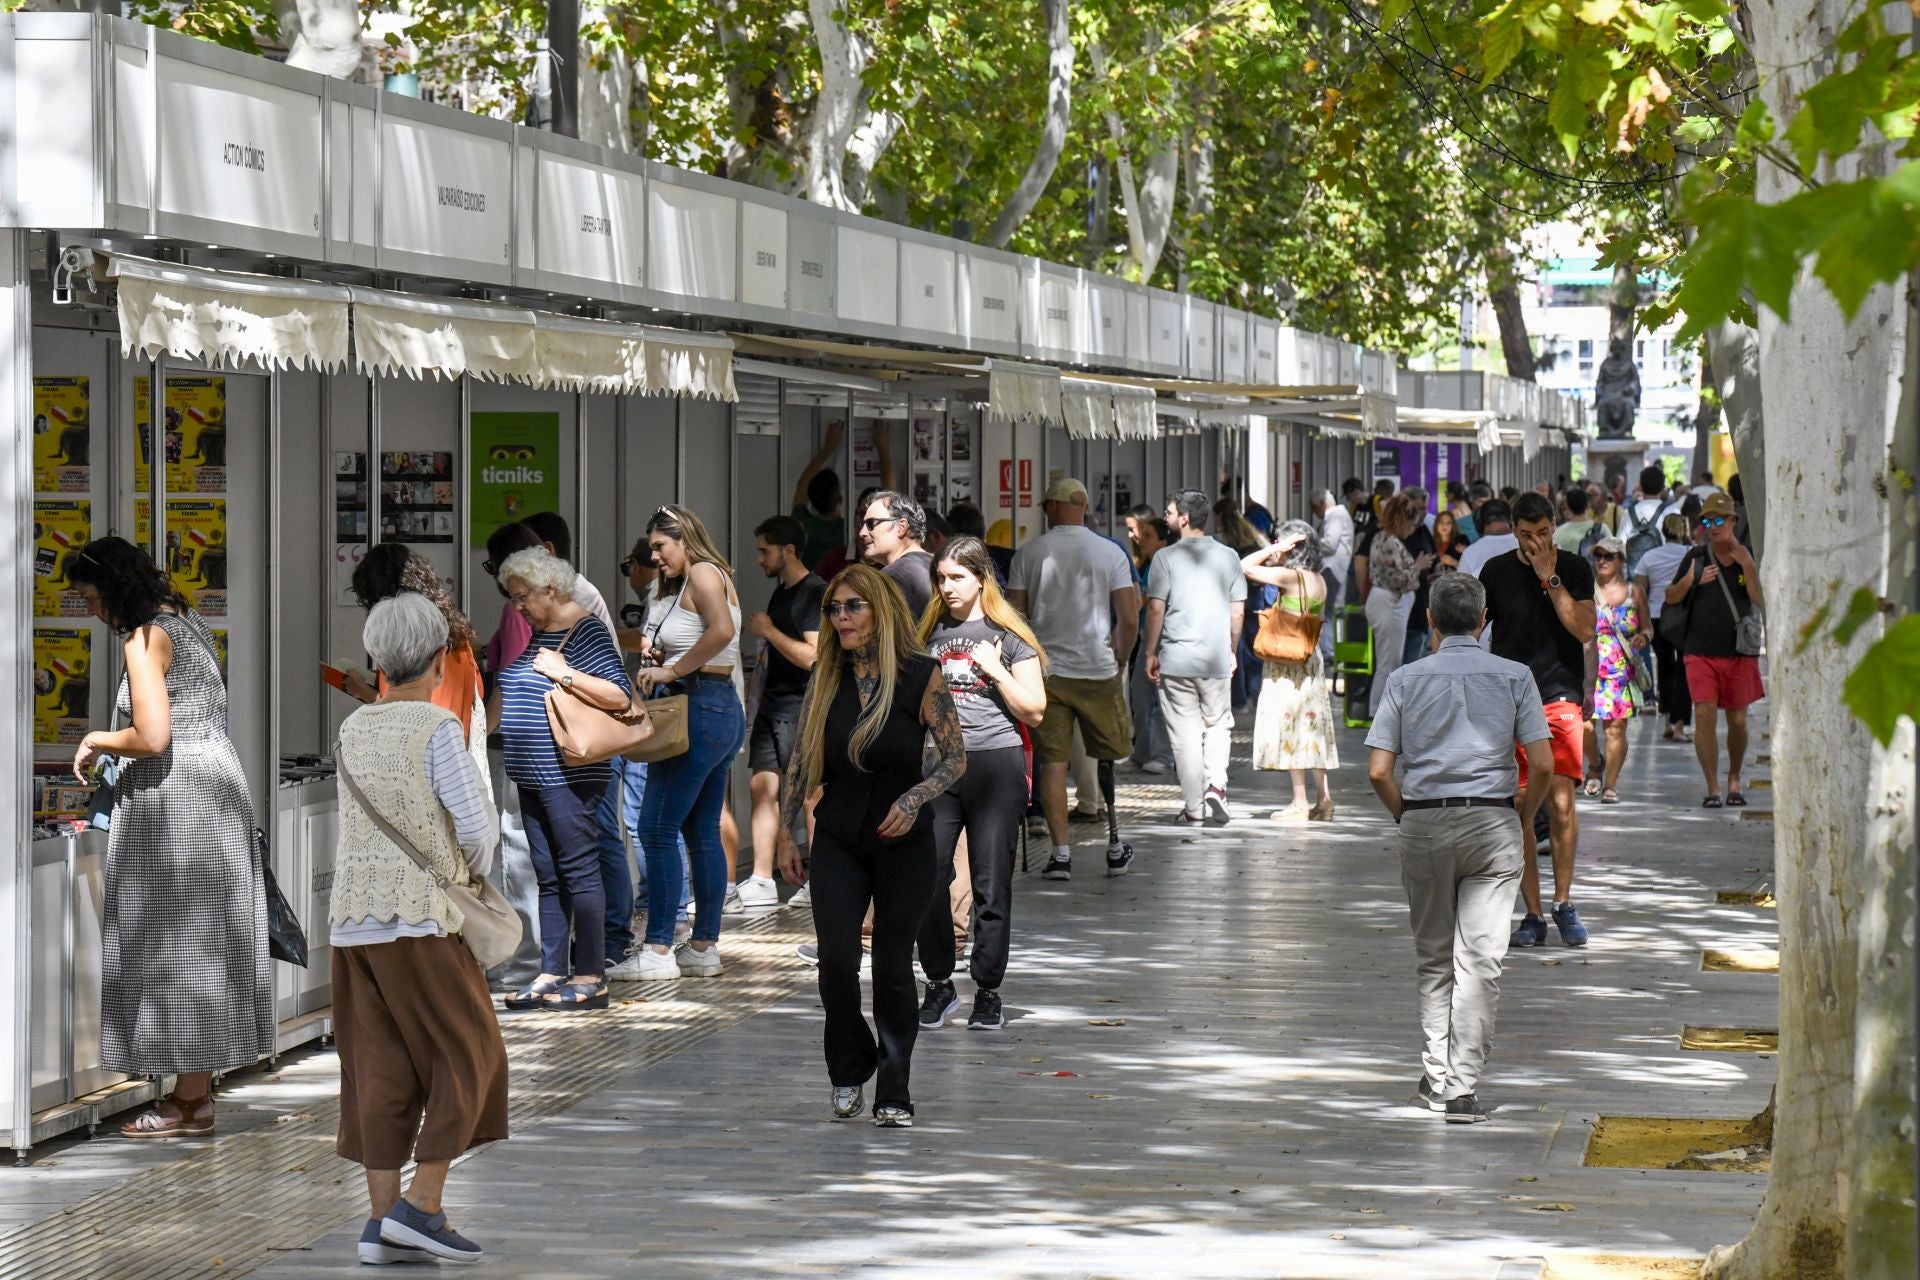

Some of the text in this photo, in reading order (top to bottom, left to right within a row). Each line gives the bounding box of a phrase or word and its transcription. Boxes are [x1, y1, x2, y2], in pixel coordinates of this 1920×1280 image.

[223, 142, 243, 167] ACTION
[482, 465, 544, 484] ticniks
[937, 637, 963, 655] CUSTOM
